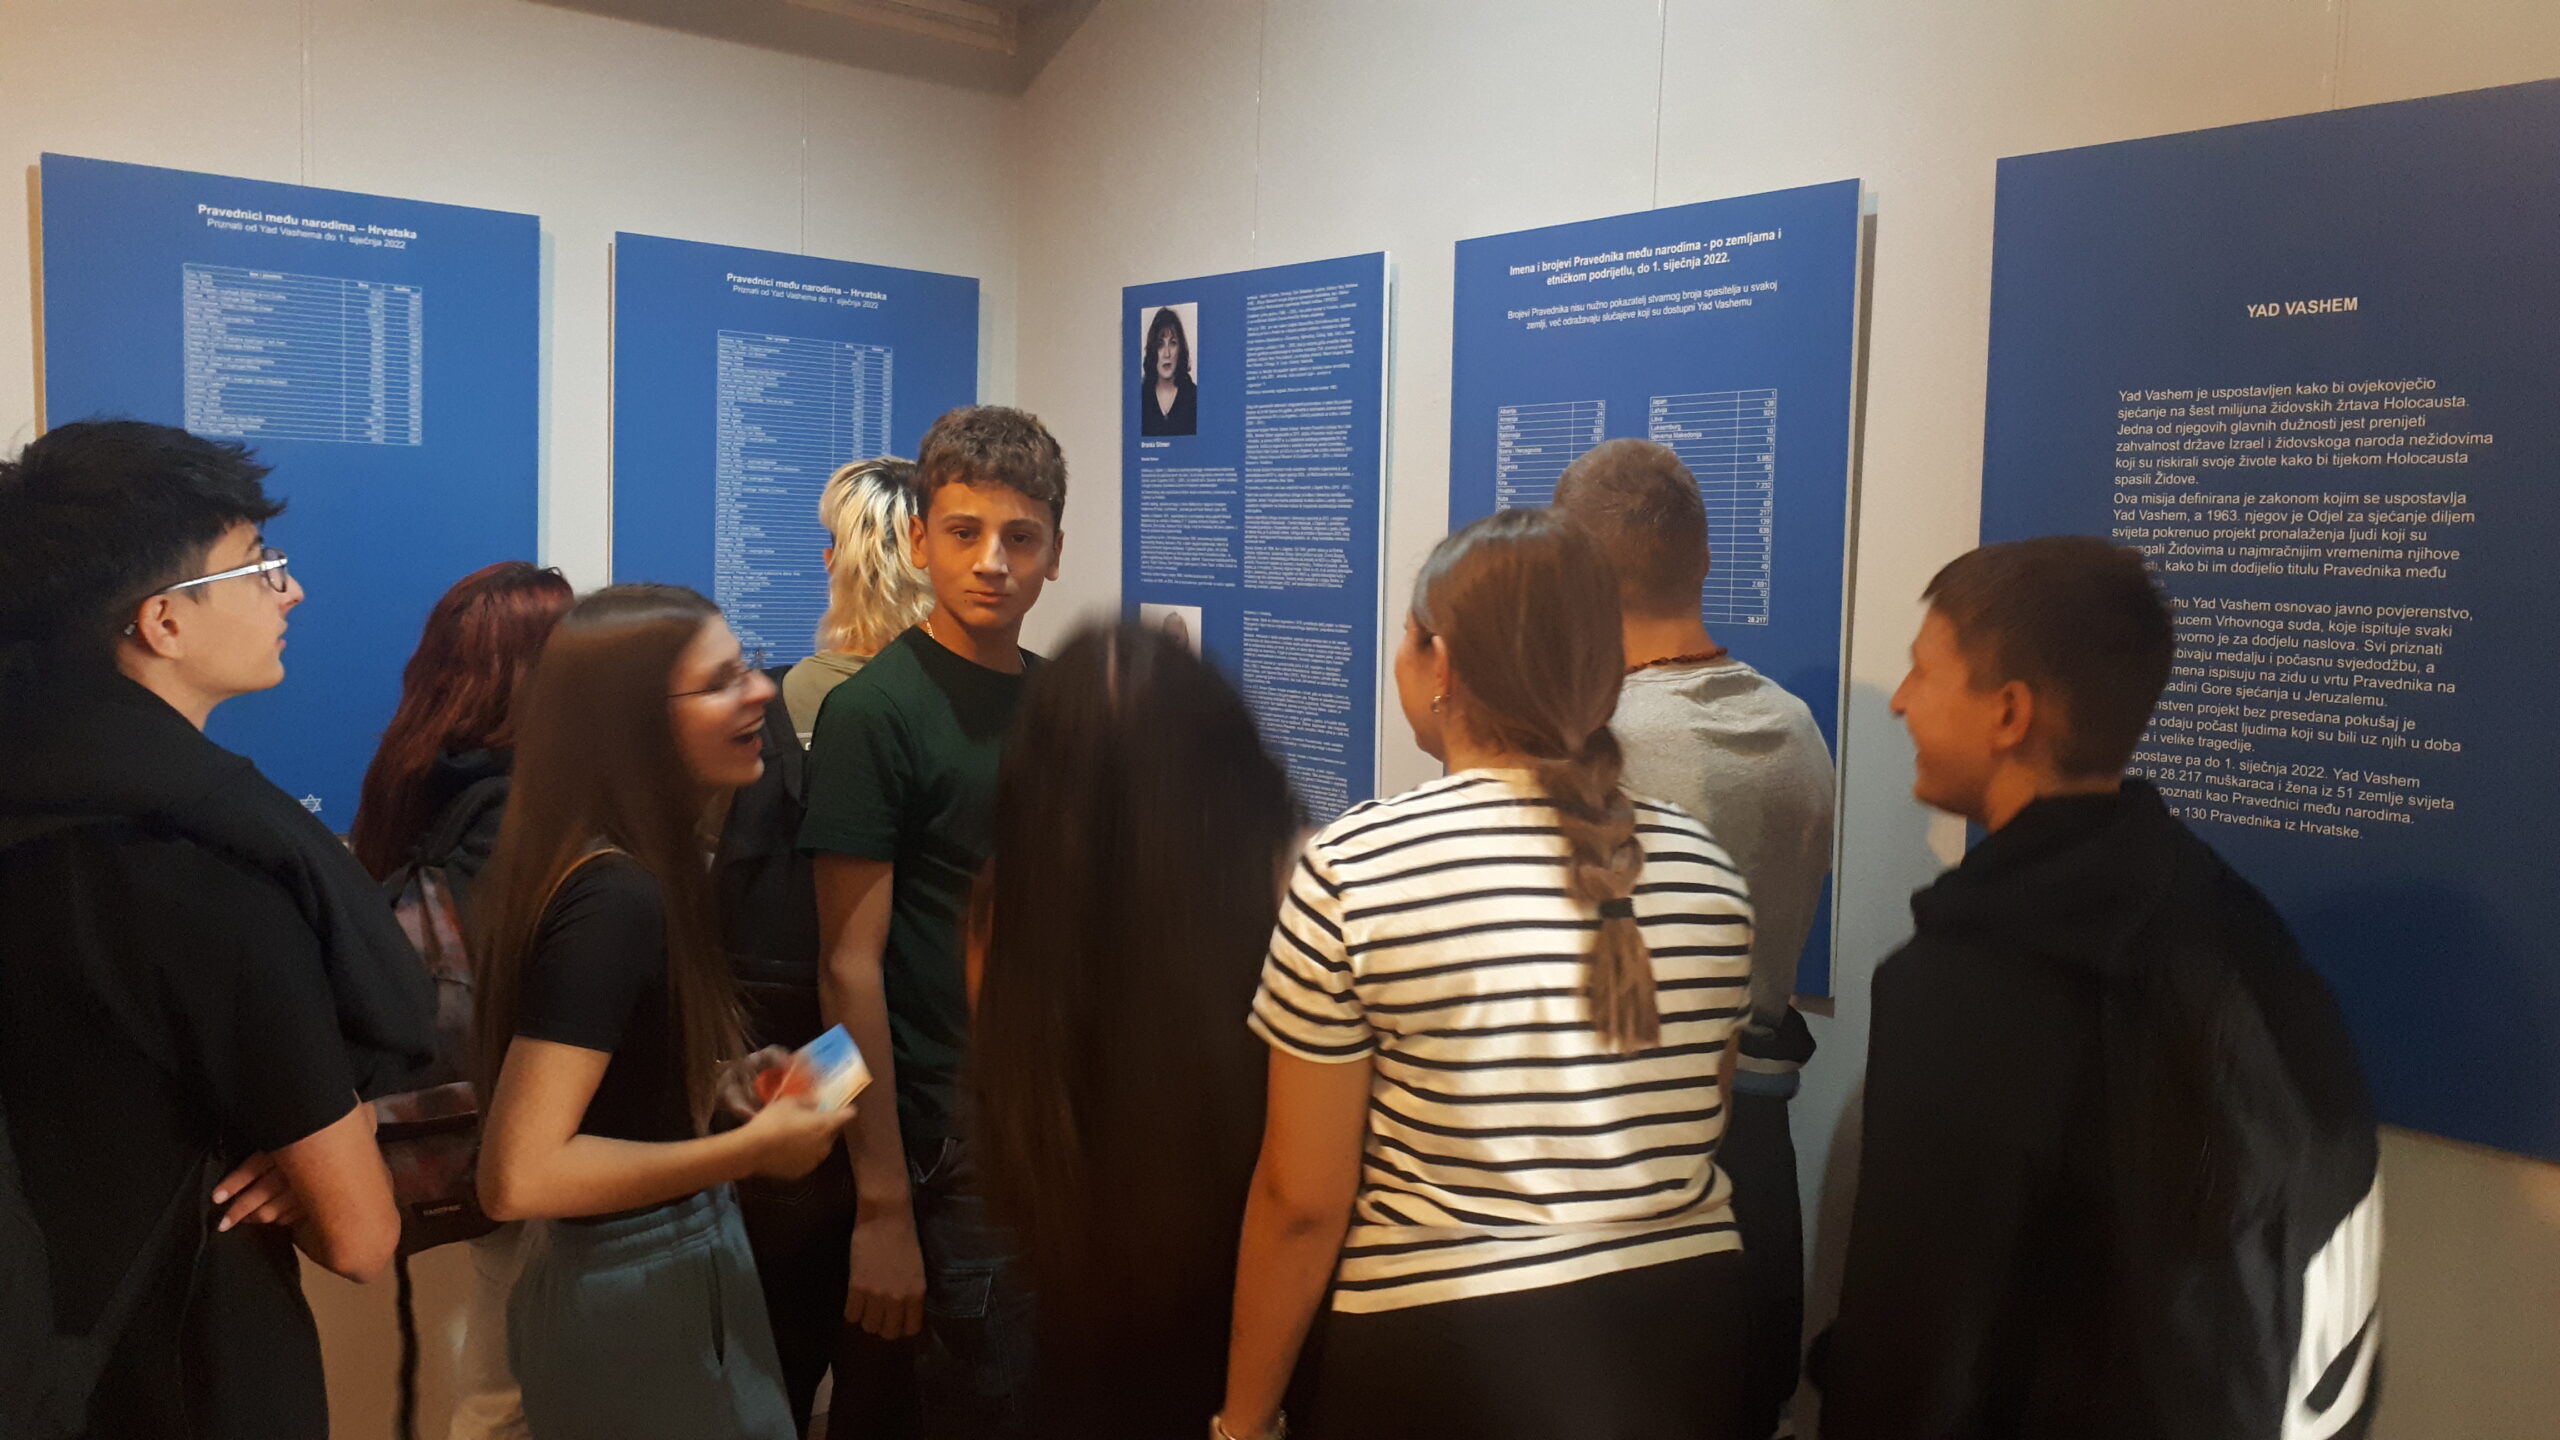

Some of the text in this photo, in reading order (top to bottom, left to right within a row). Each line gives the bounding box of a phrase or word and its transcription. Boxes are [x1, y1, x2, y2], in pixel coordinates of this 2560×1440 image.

[198, 205, 417, 238] Pravednici među narodima Hrvatska
[1509, 232, 1775, 275] Imena brojevi Pravednika među narodima po zemljama
[1546, 271, 1587, 284] etničkom
[1636, 263, 1650, 274] do
[1662, 257, 1701, 272] siječnja
[727, 274, 887, 299] Pravednici među narodima Hrvatska
[2246, 297, 2358, 318] YAD VASHEM
[2144, 377, 2436, 400] Vashem uspostavljen kako ovjekovječio
[2116, 396, 2470, 421] sjećanje šest milijuna židovskih žrtava Holocausta.
[2116, 414, 2426, 436] Jedna njegovih glavnih dužnosti jest prenijeti
[2115, 432, 2493, 451] zahvalnost države Izrael židovskoga naroda nežidovima
[2115, 452, 2468, 470] koji riskirali svoje živote kako tijekom Holocausta
[2113, 470, 2199, 487] spasili Židove.
[2140, 491, 2466, 507] misija definirana zakonom kojim uspostavlja
[2138, 509, 2475, 525] Vashem, 1963. njegov Odjel sjećanje diljem
[2111, 526, 2406, 543] svijeta pokrenuo projekt pronalaženja ljudi koji
[2167, 540, 2460, 562] Židovima najmračnijim vremenima njihove
[2164, 559, 2447, 578] kako dodijelio titulu Pravednika među
[2218, 598, 2473, 621] Vashem osnovao javno povjerenstvo,
[2215, 616, 2453, 638] Vrhovnoga suda, koje ispituje svaki
[2251, 634, 2443, 656] dodjelu naslova. priznati
[2215, 651, 2420, 674] medalju počasnu svjedodžbu,
[2207, 666, 2433, 691] ispisuju zidu vrtu Pravednika
[2200, 683, 2388, 706] Gore sjećanja Jeruzalemu.
[2196, 703, 2399, 731] projekt presedana pokušaj
[2159, 716, 2461, 752] odaju počast ljudima koji bili njih doba
[2159, 733, 2255, 754] velike tragedije.
[2238, 759, 2420, 785] siječnja 2022. Vashem
[2159, 768, 2454, 810] 28.217 muškaraca žena zemlje svijeta
[2231, 792, 2415, 822] Pravednici među narodima.
[2184, 807, 2363, 839] 130 Pravednika Hrvatske.
